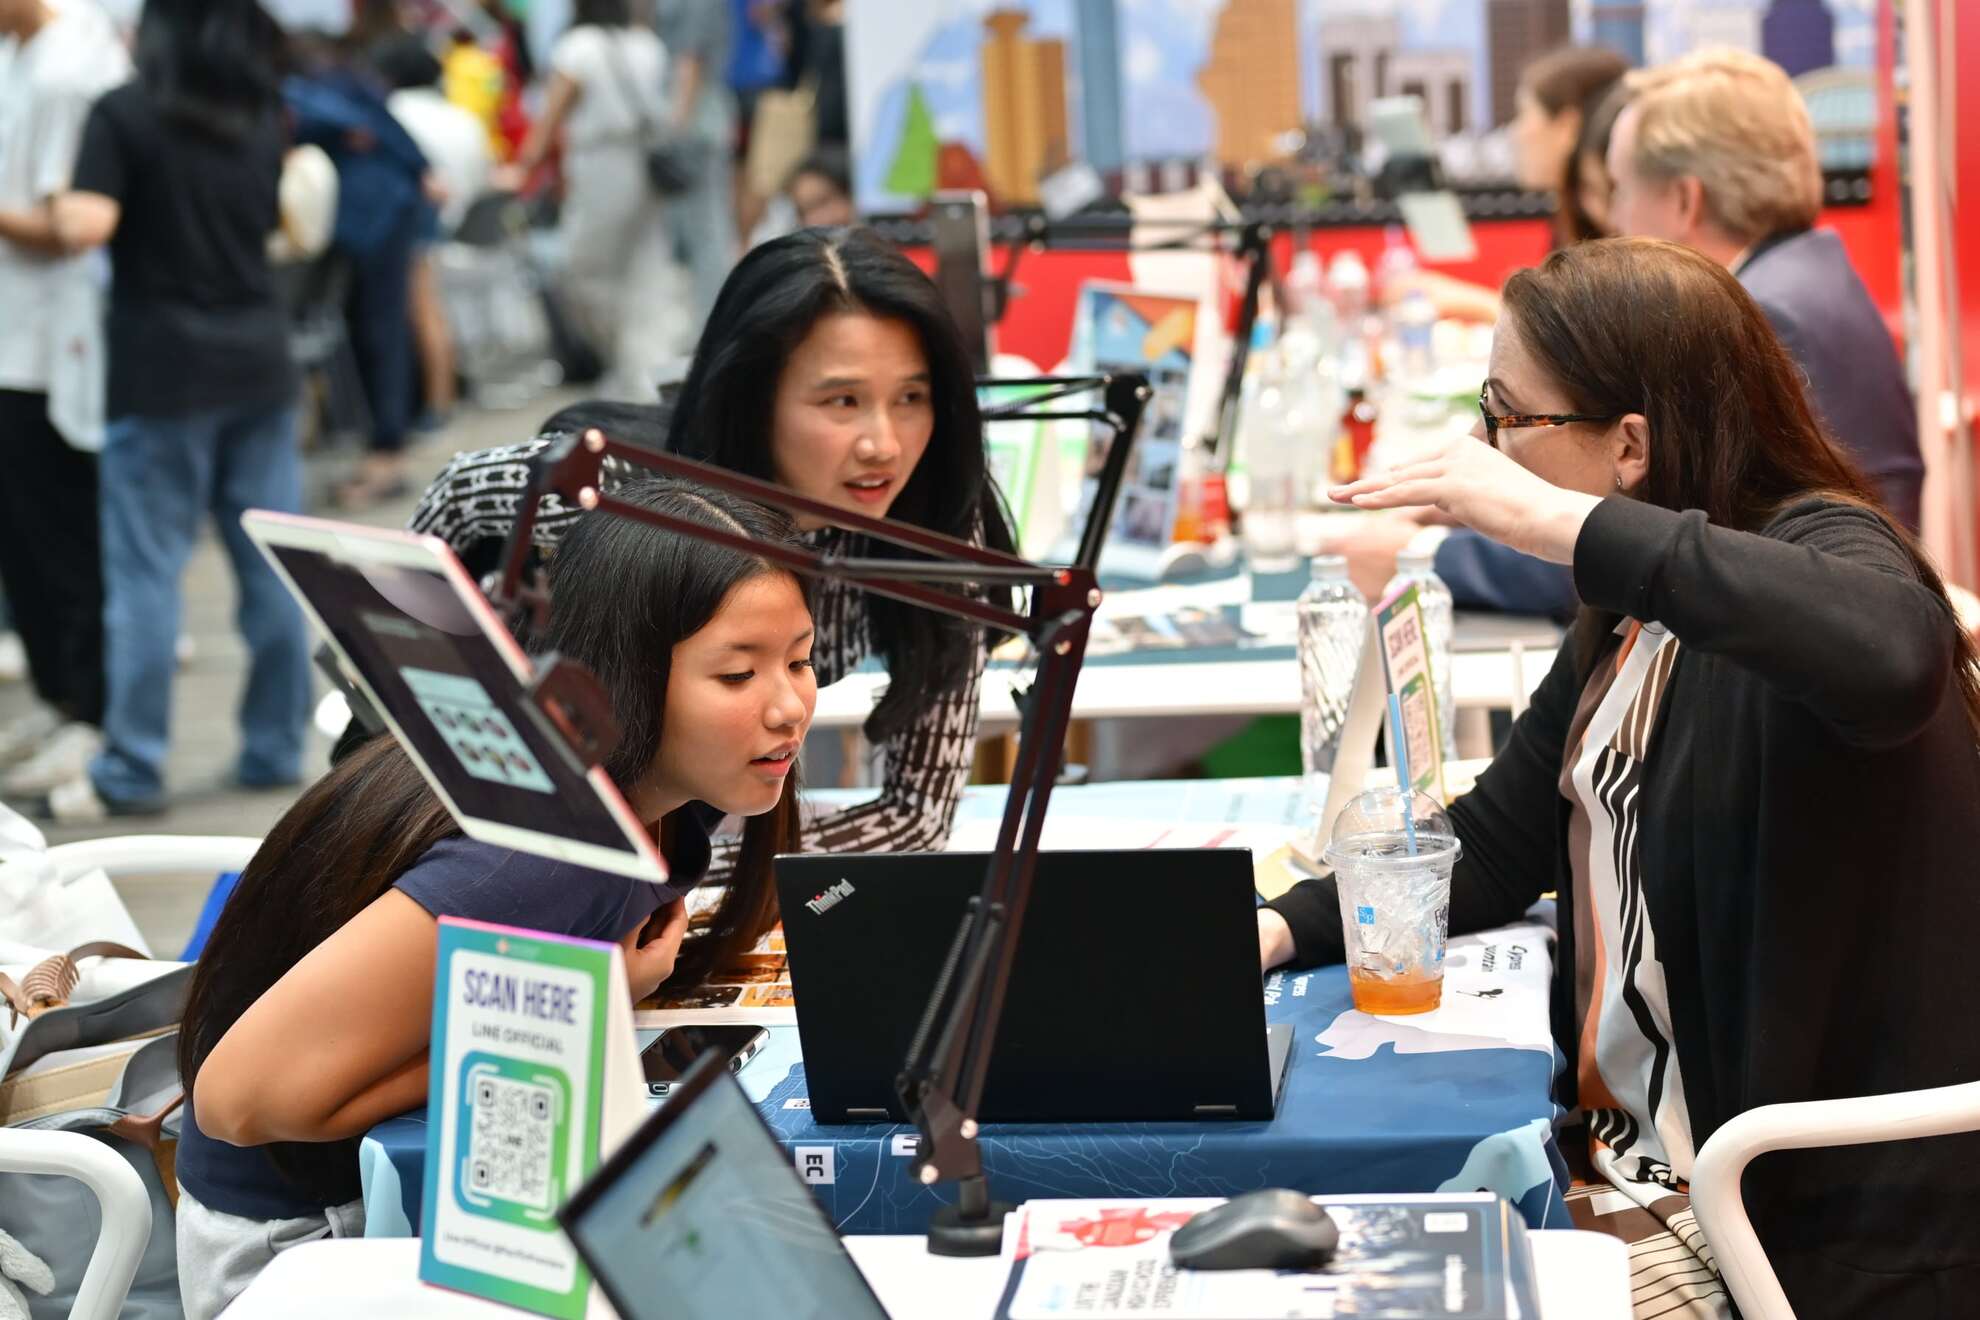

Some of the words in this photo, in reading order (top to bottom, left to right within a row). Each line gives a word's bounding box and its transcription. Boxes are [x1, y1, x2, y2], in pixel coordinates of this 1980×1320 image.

[804, 877, 856, 915] ThinkPad
[1507, 945, 1528, 971] Cypress
[463, 968, 517, 1014] SCAN
[522, 979, 577, 1026] HERE
[472, 1020, 500, 1041] LINE
[503, 1028, 564, 1056] OFFICIAL
[806, 1154, 824, 1178] EC
